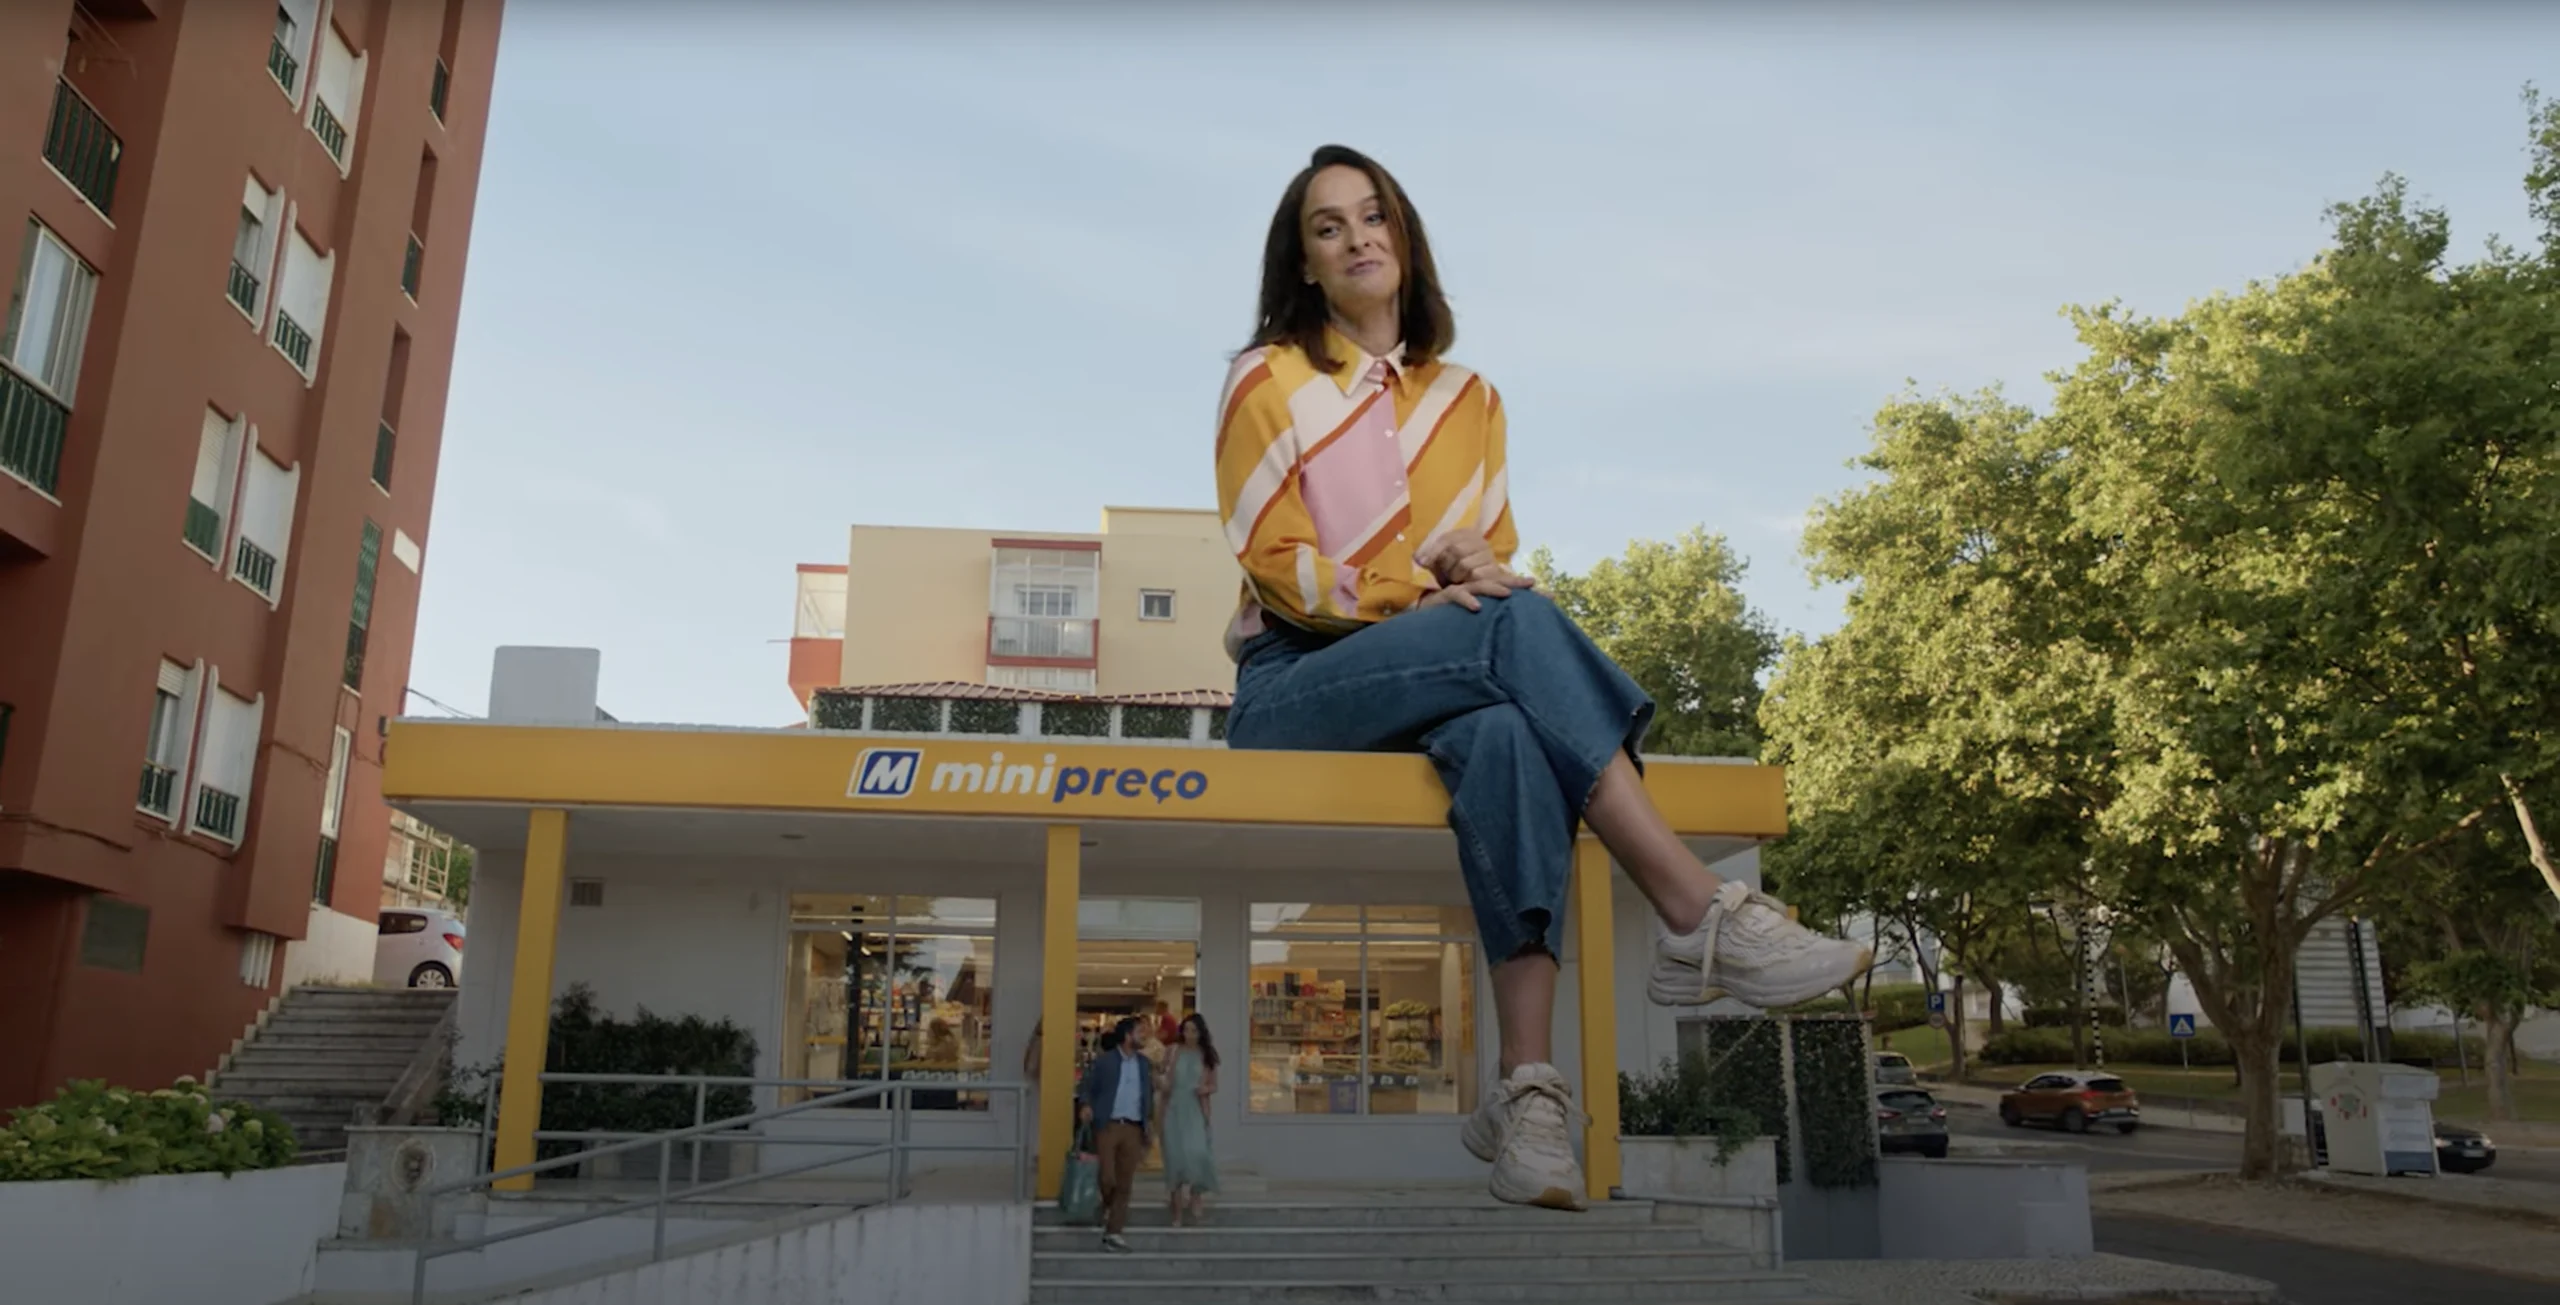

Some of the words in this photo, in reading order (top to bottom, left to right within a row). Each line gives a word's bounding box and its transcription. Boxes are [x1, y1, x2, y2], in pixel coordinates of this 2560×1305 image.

[862, 755, 914, 792] M
[930, 751, 1208, 804] minipreço
[1930, 995, 1941, 1009] P
